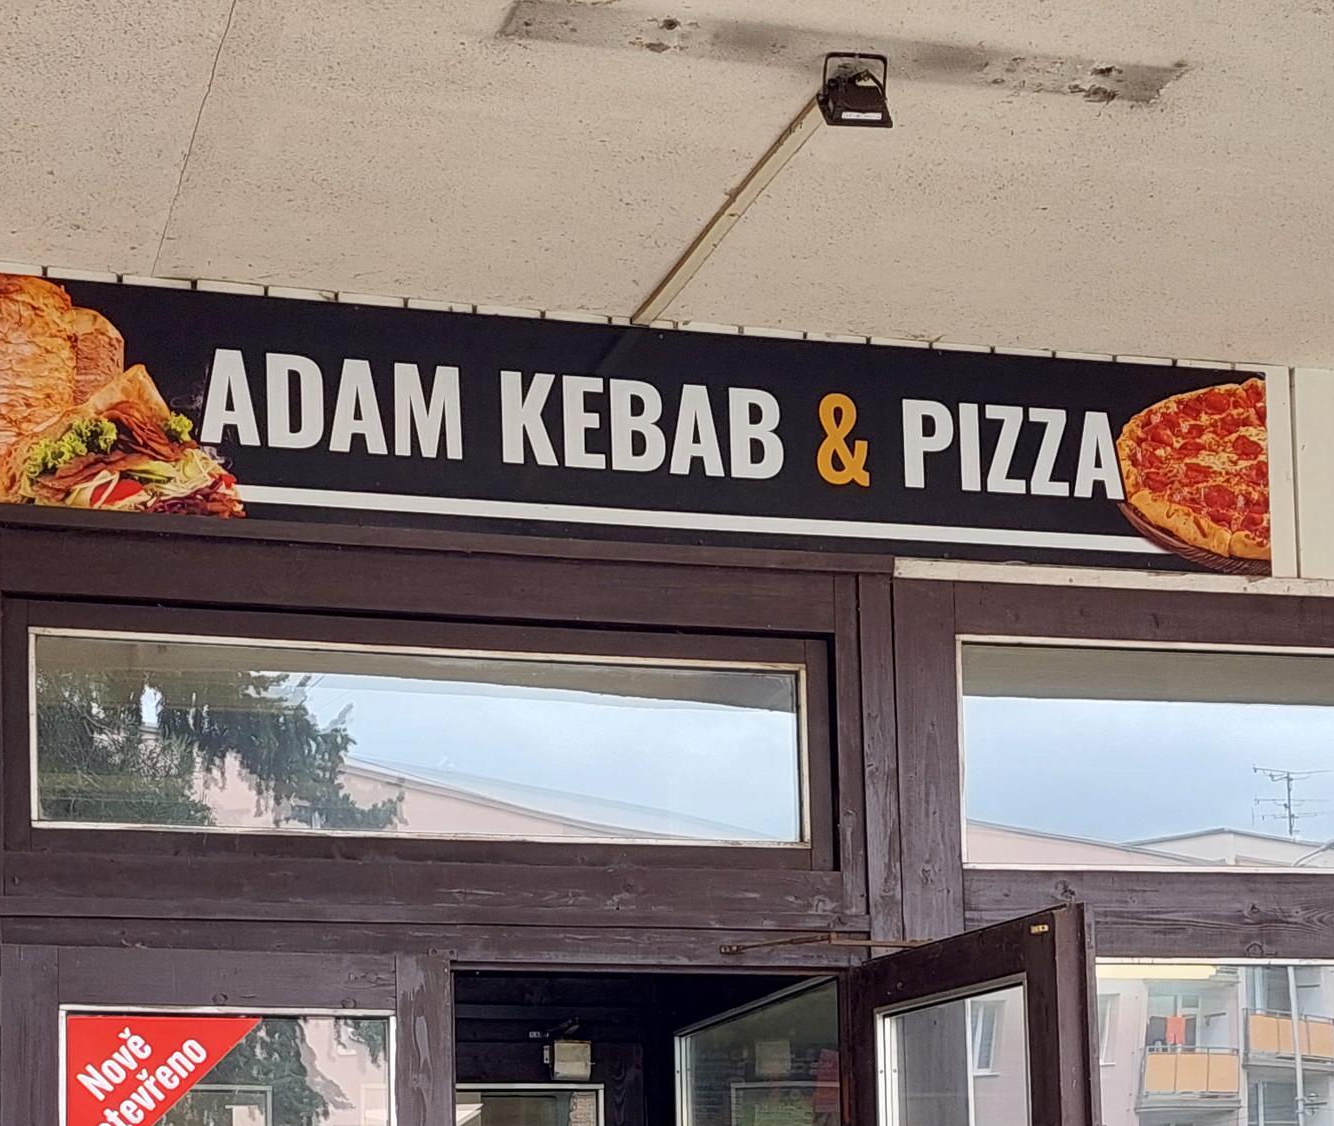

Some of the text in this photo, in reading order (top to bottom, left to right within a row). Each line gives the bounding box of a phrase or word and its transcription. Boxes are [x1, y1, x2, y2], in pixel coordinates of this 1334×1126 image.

[199, 347, 1125, 501] ADAM KEBAB & PIZZA
[76, 1026, 153, 1102] Nově
